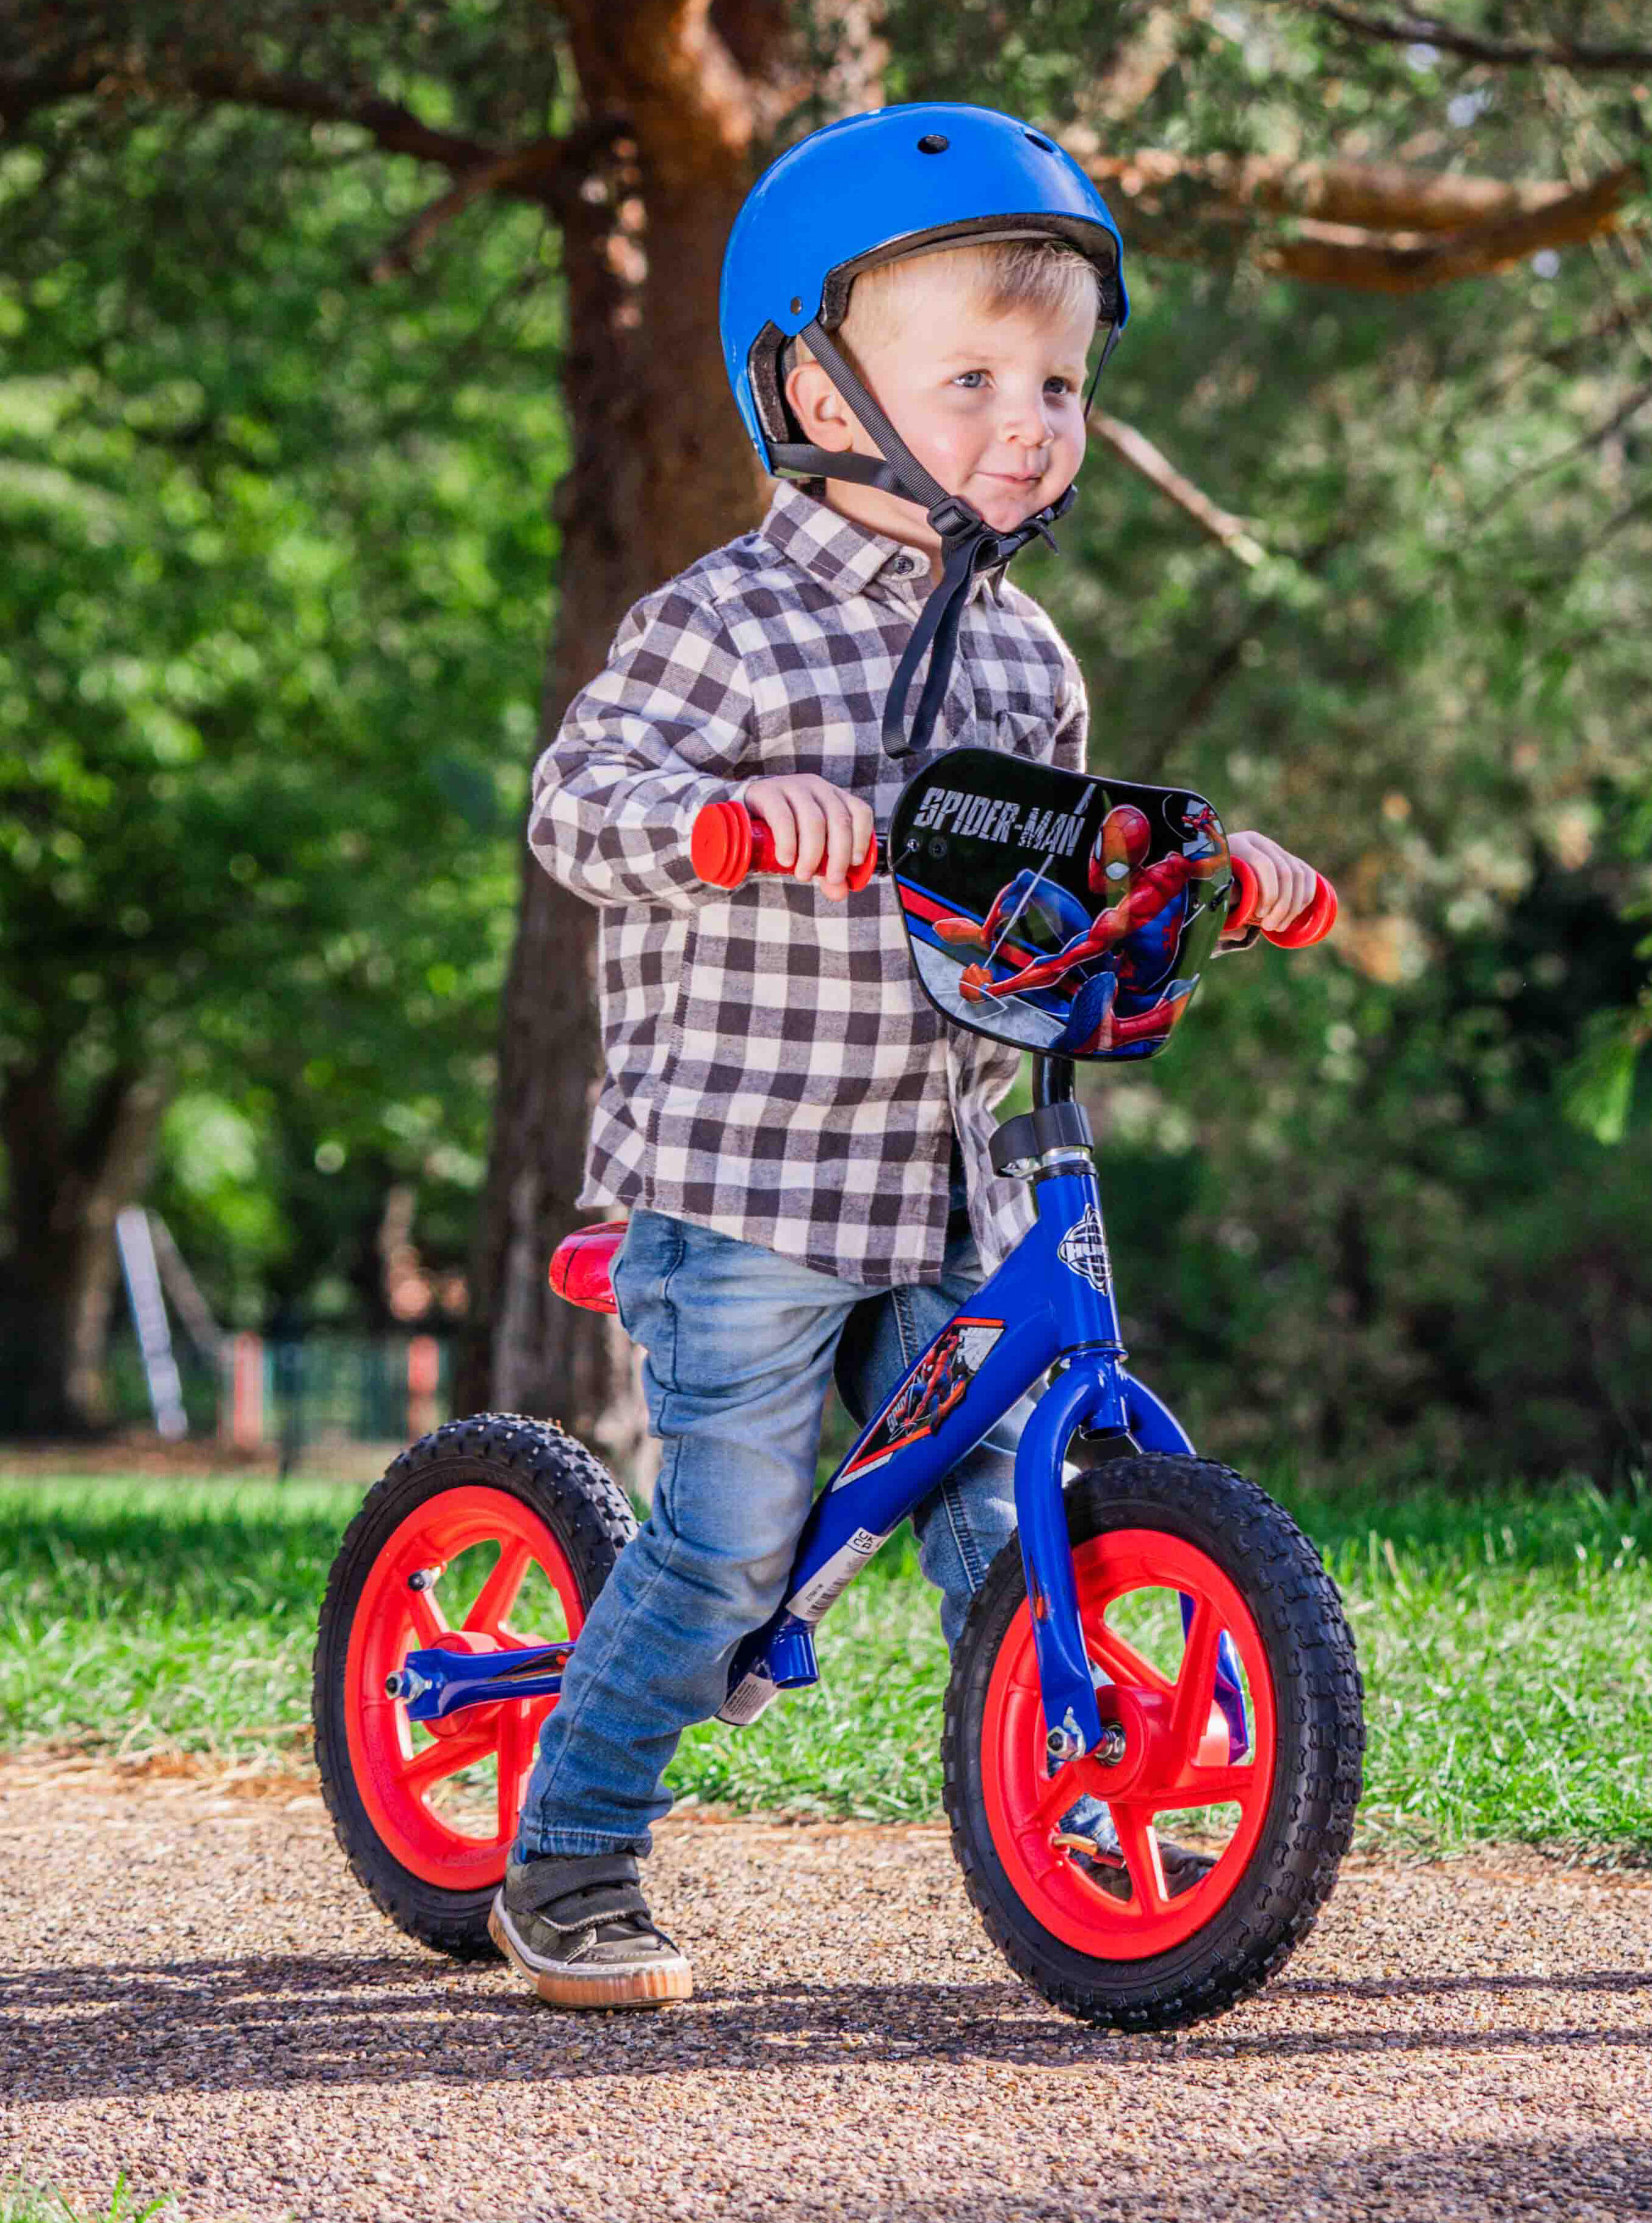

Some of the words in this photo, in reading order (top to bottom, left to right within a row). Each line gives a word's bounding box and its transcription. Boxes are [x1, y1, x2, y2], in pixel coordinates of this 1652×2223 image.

[913, 786, 1085, 856] SPIDER-MAN
[858, 1531, 873, 1543] UK
[853, 1538, 872, 1550] CA
